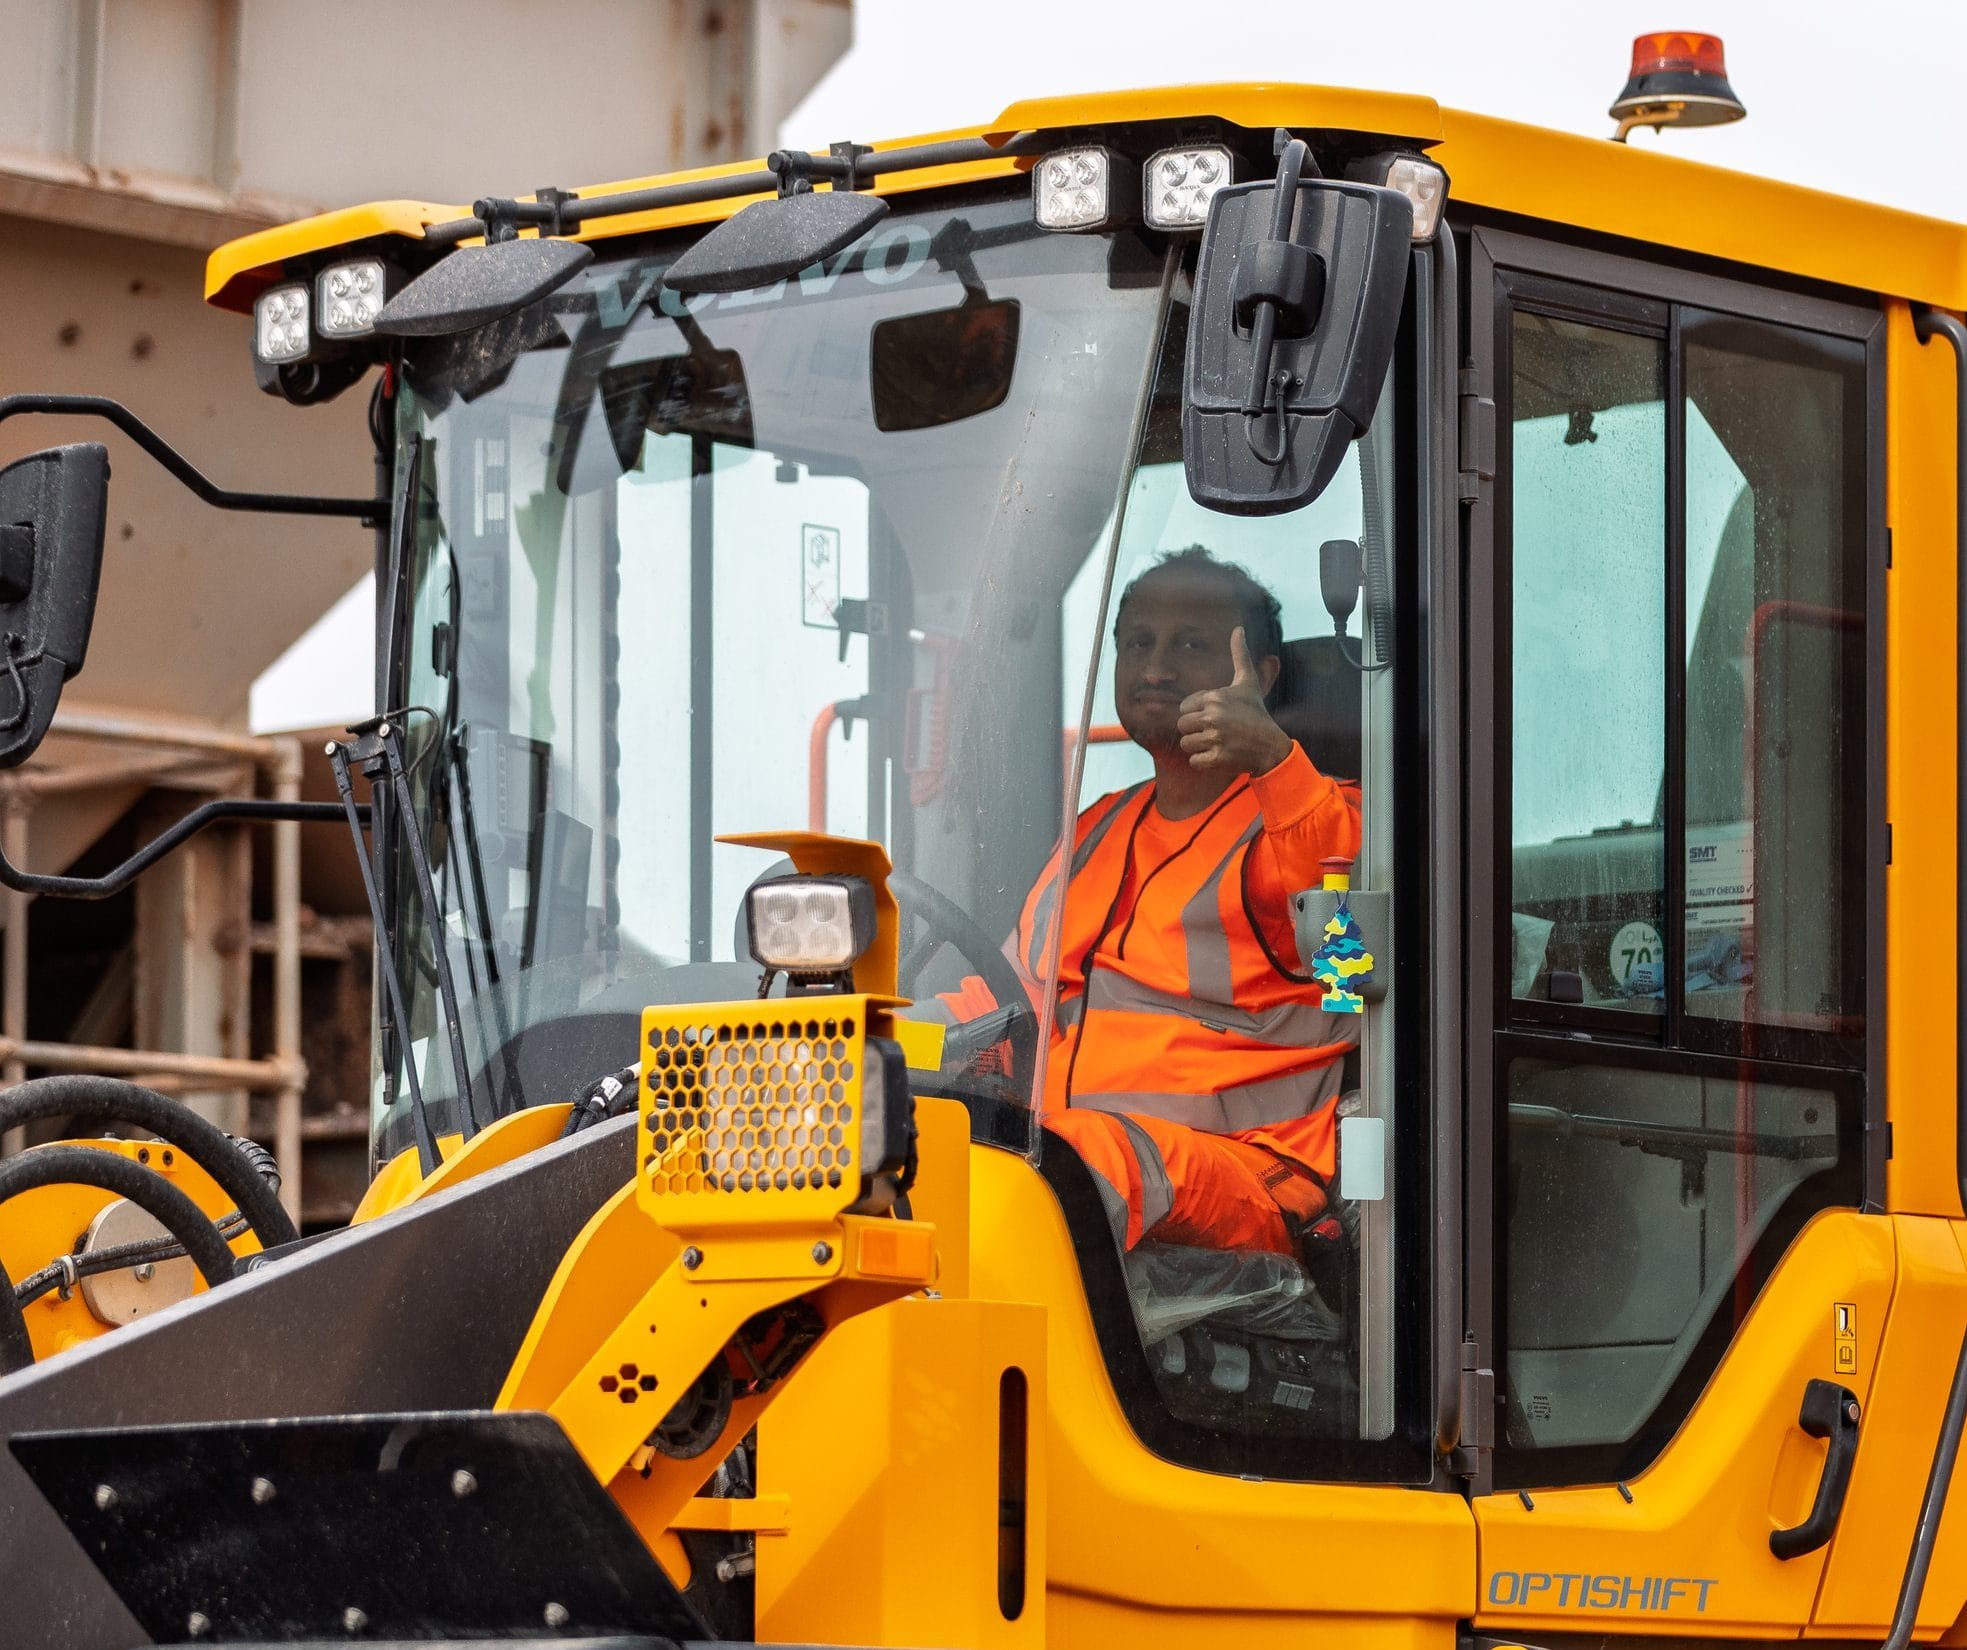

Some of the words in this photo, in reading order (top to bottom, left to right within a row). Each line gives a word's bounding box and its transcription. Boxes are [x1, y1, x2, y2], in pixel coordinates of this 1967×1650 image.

[1689, 846, 1716, 859] SMT
[1689, 886, 1715, 897] QUALITY
[1716, 884, 1745, 896] CHECKED
[1488, 1571, 1719, 1612] OPTISHIFT
